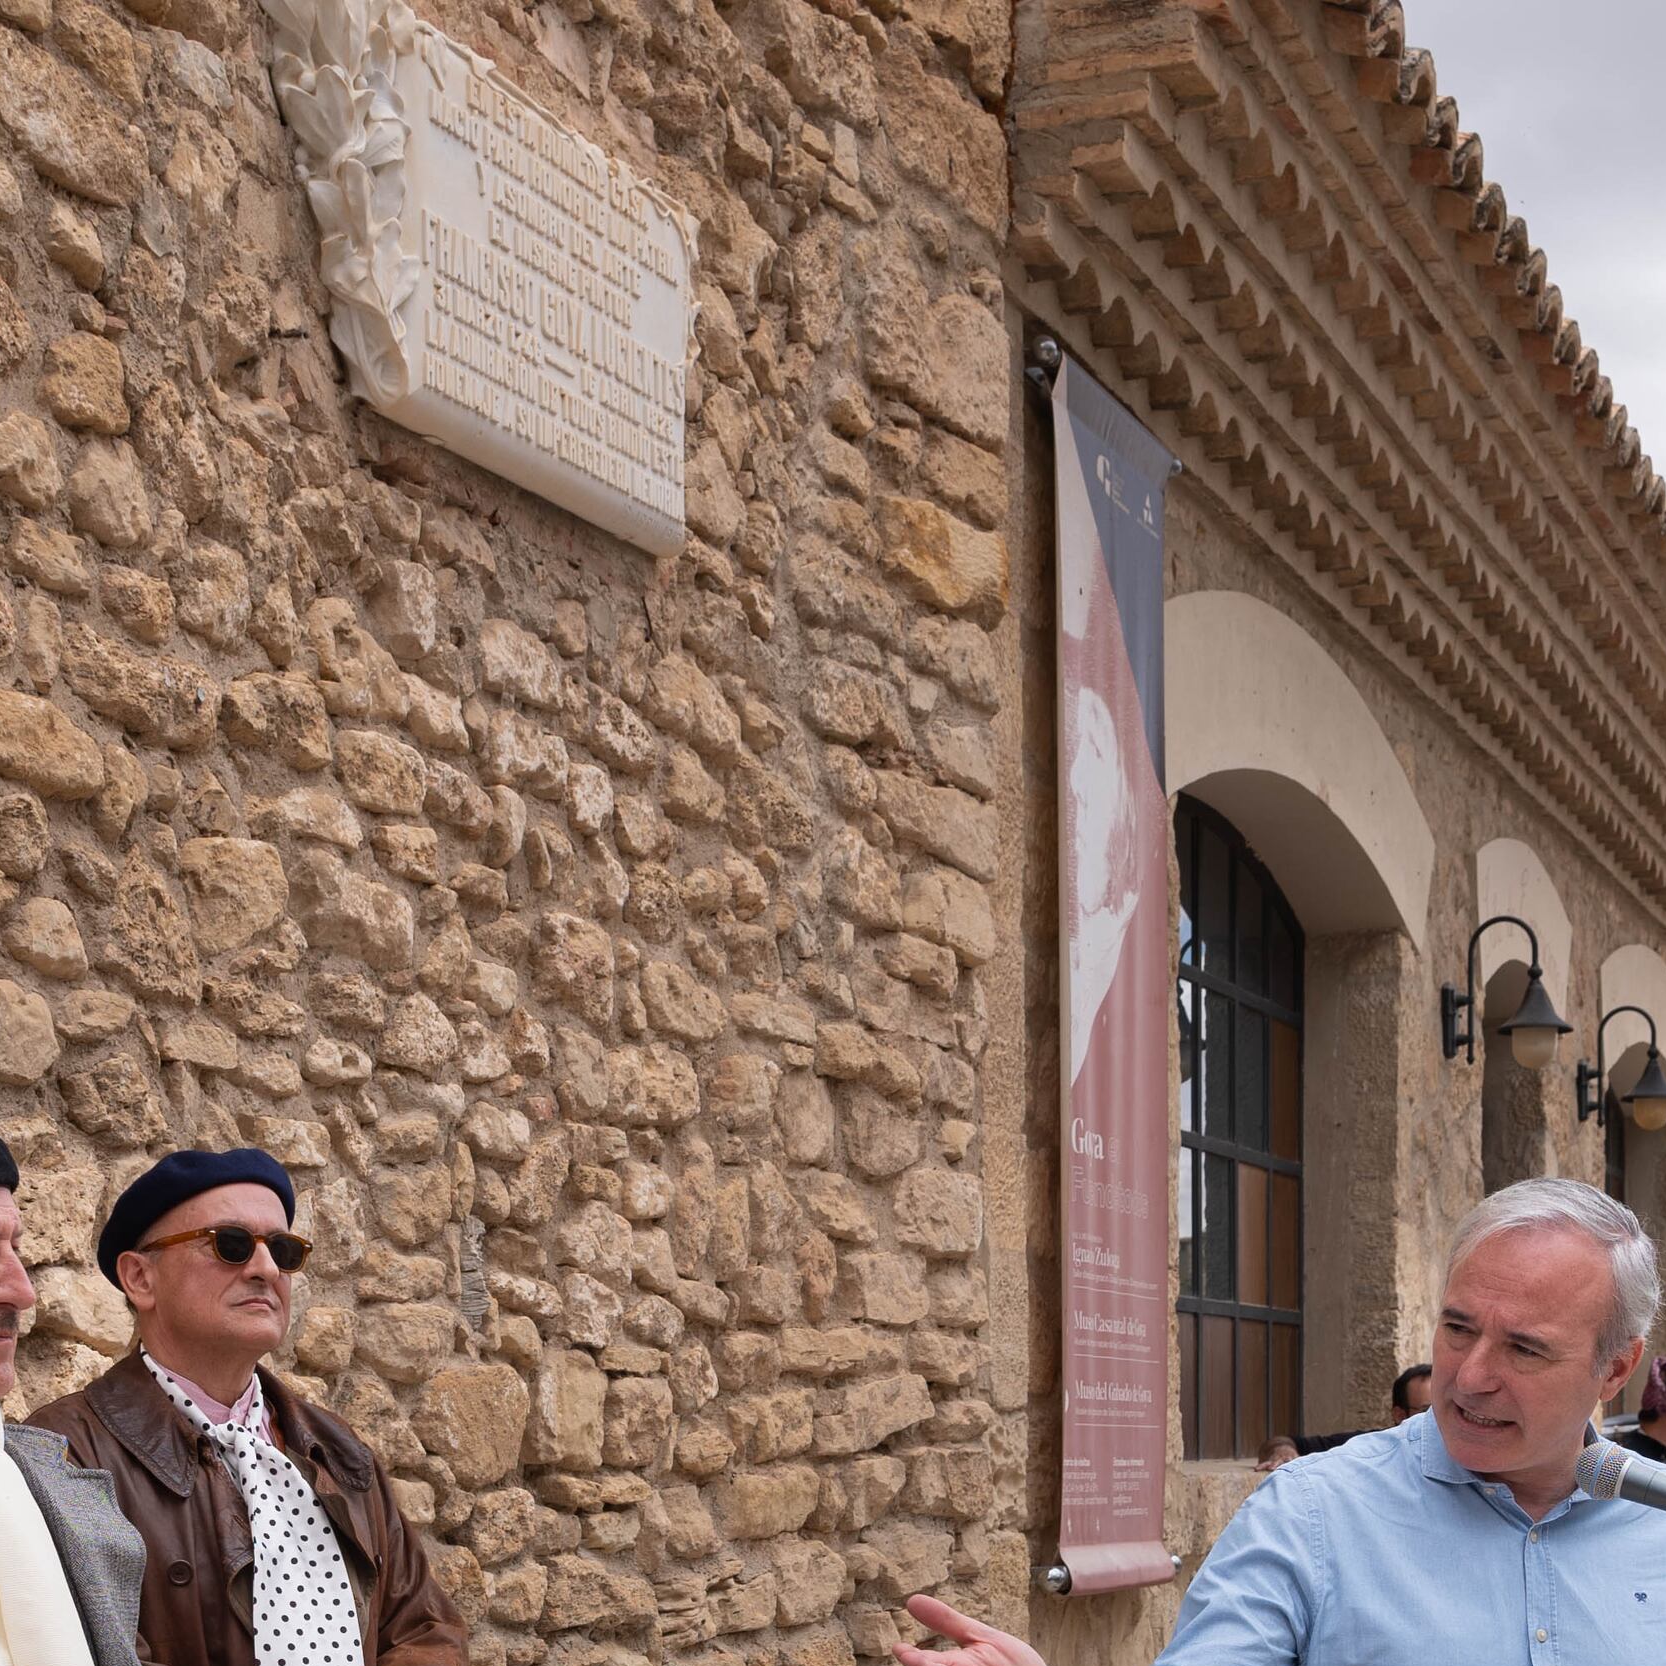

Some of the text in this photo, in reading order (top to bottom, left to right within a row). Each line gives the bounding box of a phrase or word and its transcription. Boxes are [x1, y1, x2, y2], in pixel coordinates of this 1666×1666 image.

[466, 73, 649, 233] EN ESTA HUMILDE CASA
[482, 123, 525, 184] PARA
[528, 154, 580, 223] HONOR
[583, 194, 604, 239] DE
[607, 211, 627, 255] LA
[631, 227, 677, 289] PATRIA
[487, 206, 632, 332] EL INSIGNE PINTOR
[493, 171, 564, 250] ASOMBRO
[569, 222, 598, 274] DEL
[602, 245, 641, 301] ARTE
[420, 206, 685, 421] FRANCISCO GOYA LUCIENTES
[453, 286, 502, 346] MARZO
[599, 374, 641, 429] ABRIL
[421, 348, 500, 427] HOMENAJE
[516, 400, 533, 445] SU
[424, 307, 446, 356] LA
[538, 373, 557, 419] DE
[559, 385, 605, 445] TODOS
[651, 439, 684, 490] ESTE
